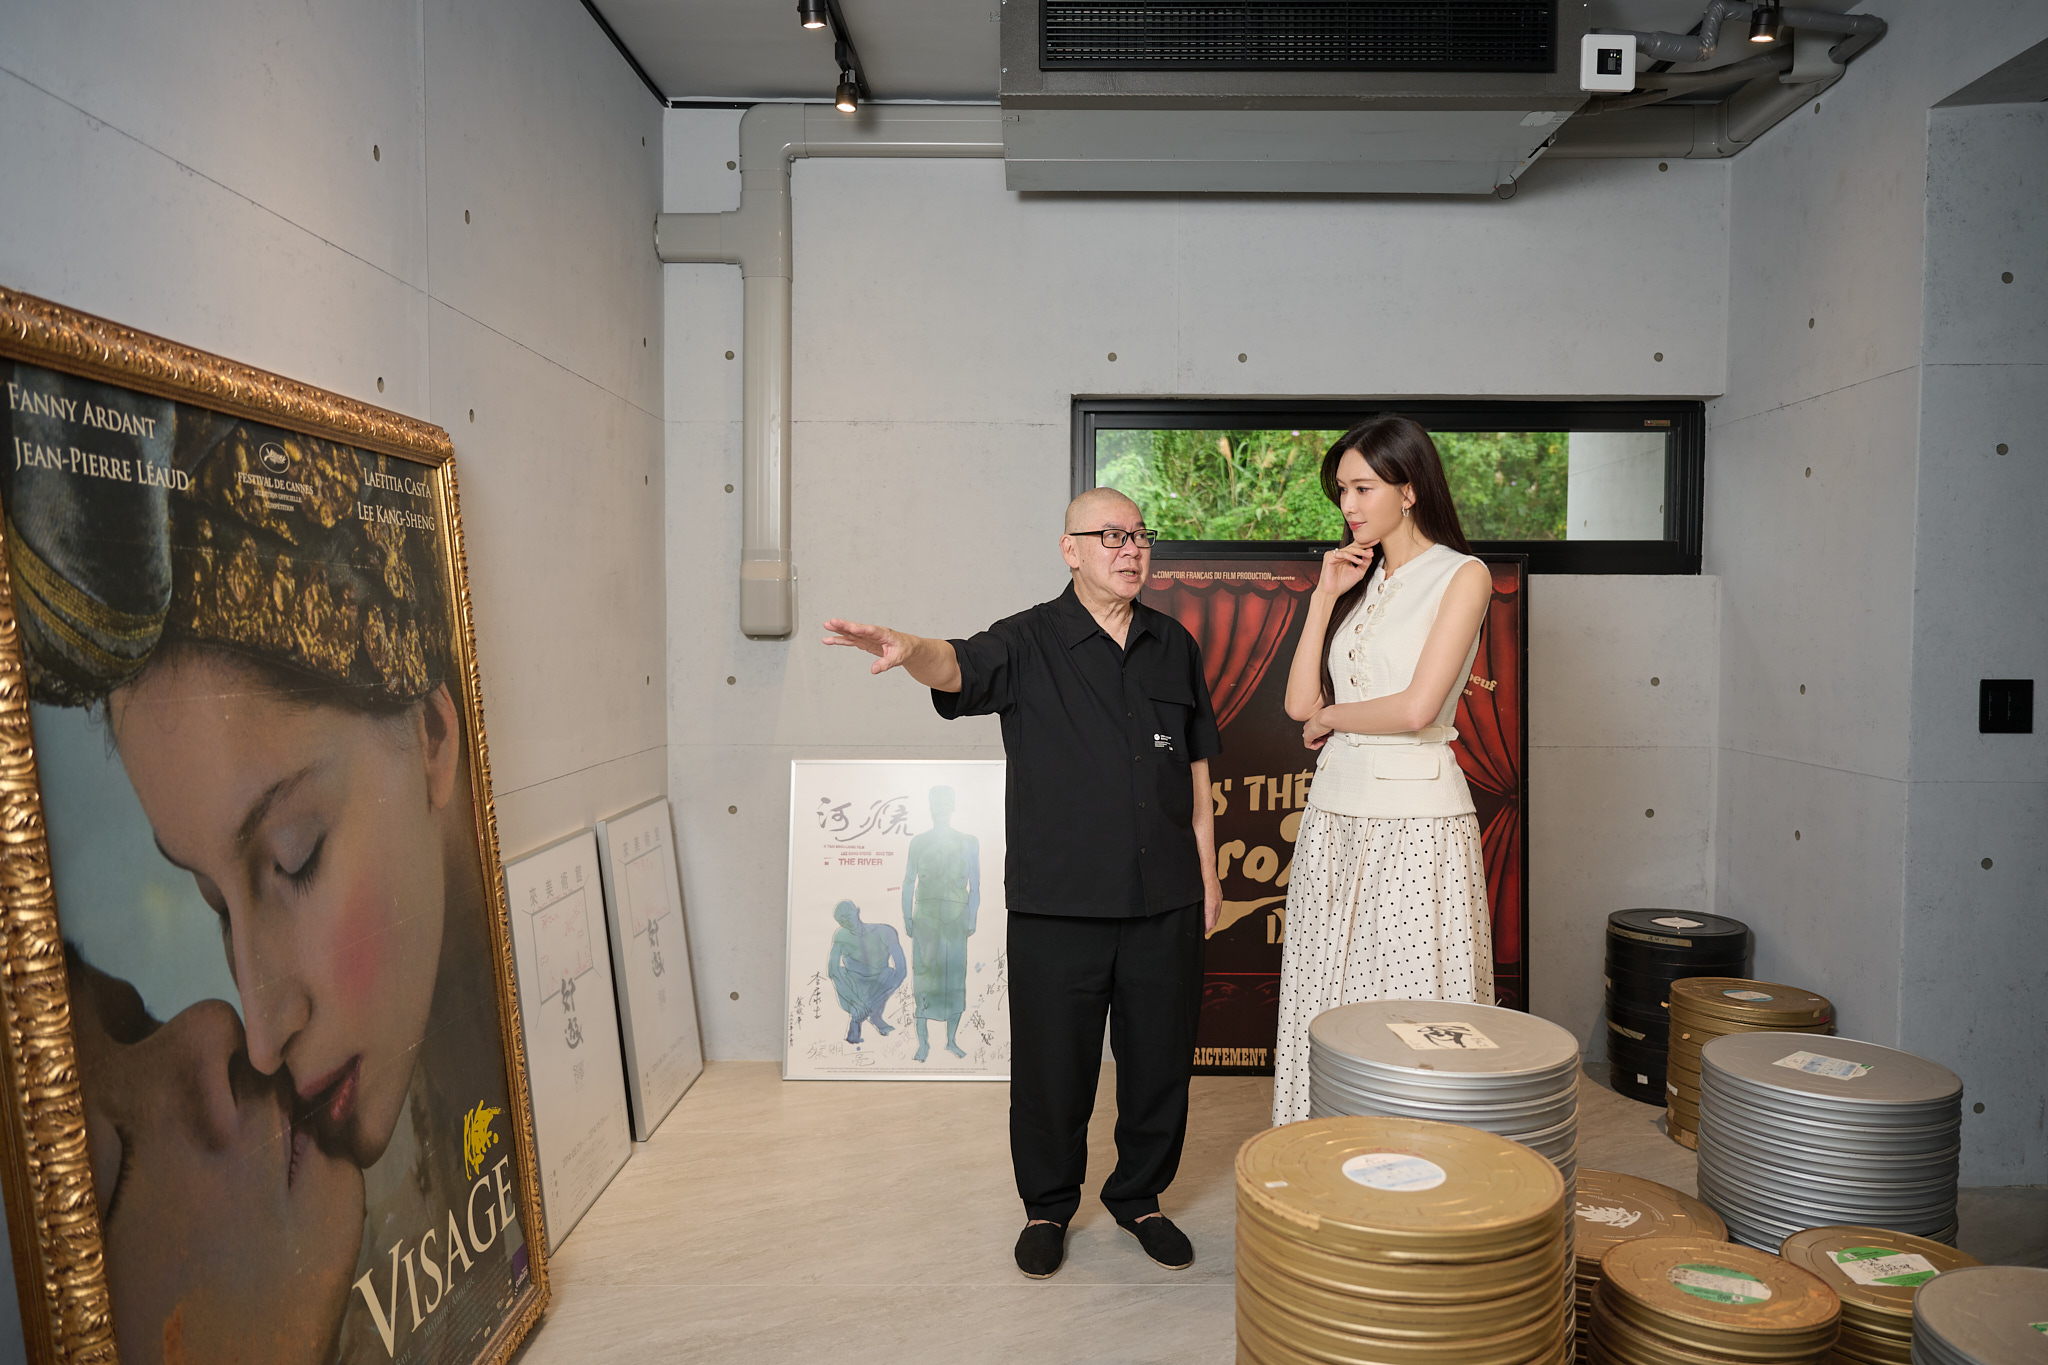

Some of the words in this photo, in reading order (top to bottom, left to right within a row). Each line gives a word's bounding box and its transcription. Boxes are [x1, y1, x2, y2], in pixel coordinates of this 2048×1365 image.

[7, 382, 78, 422] FANNY
[82, 401, 156, 439] ARDANT
[14, 437, 132, 482] JEAN-PIERRE
[136, 460, 189, 491] LÉAUD
[238, 472, 274, 488] FESTIVAL
[274, 478, 285, 490] DE
[286, 481, 314, 495] CANNES
[363, 467, 404, 493] LAETITIA
[405, 477, 432, 499] CASTA
[357, 501, 374, 521] LEE
[376, 504, 435, 531] KANG-SHENG
[1157, 571, 1185, 579] COMPTOIR
[1186, 571, 1214, 580] FRANÇAIS
[1214, 571, 1222, 580] DU
[1223, 572, 1236, 580] FILM
[1237, 572, 1271, 580] PRODUCTION
[817, 797, 914, 842] 河流
[838, 858, 856, 866] THE
[857, 858, 883, 866] RIVER
[1193, 1047, 1267, 1066] RICTEMENT
[352, 1154, 516, 1359] VISAGE
